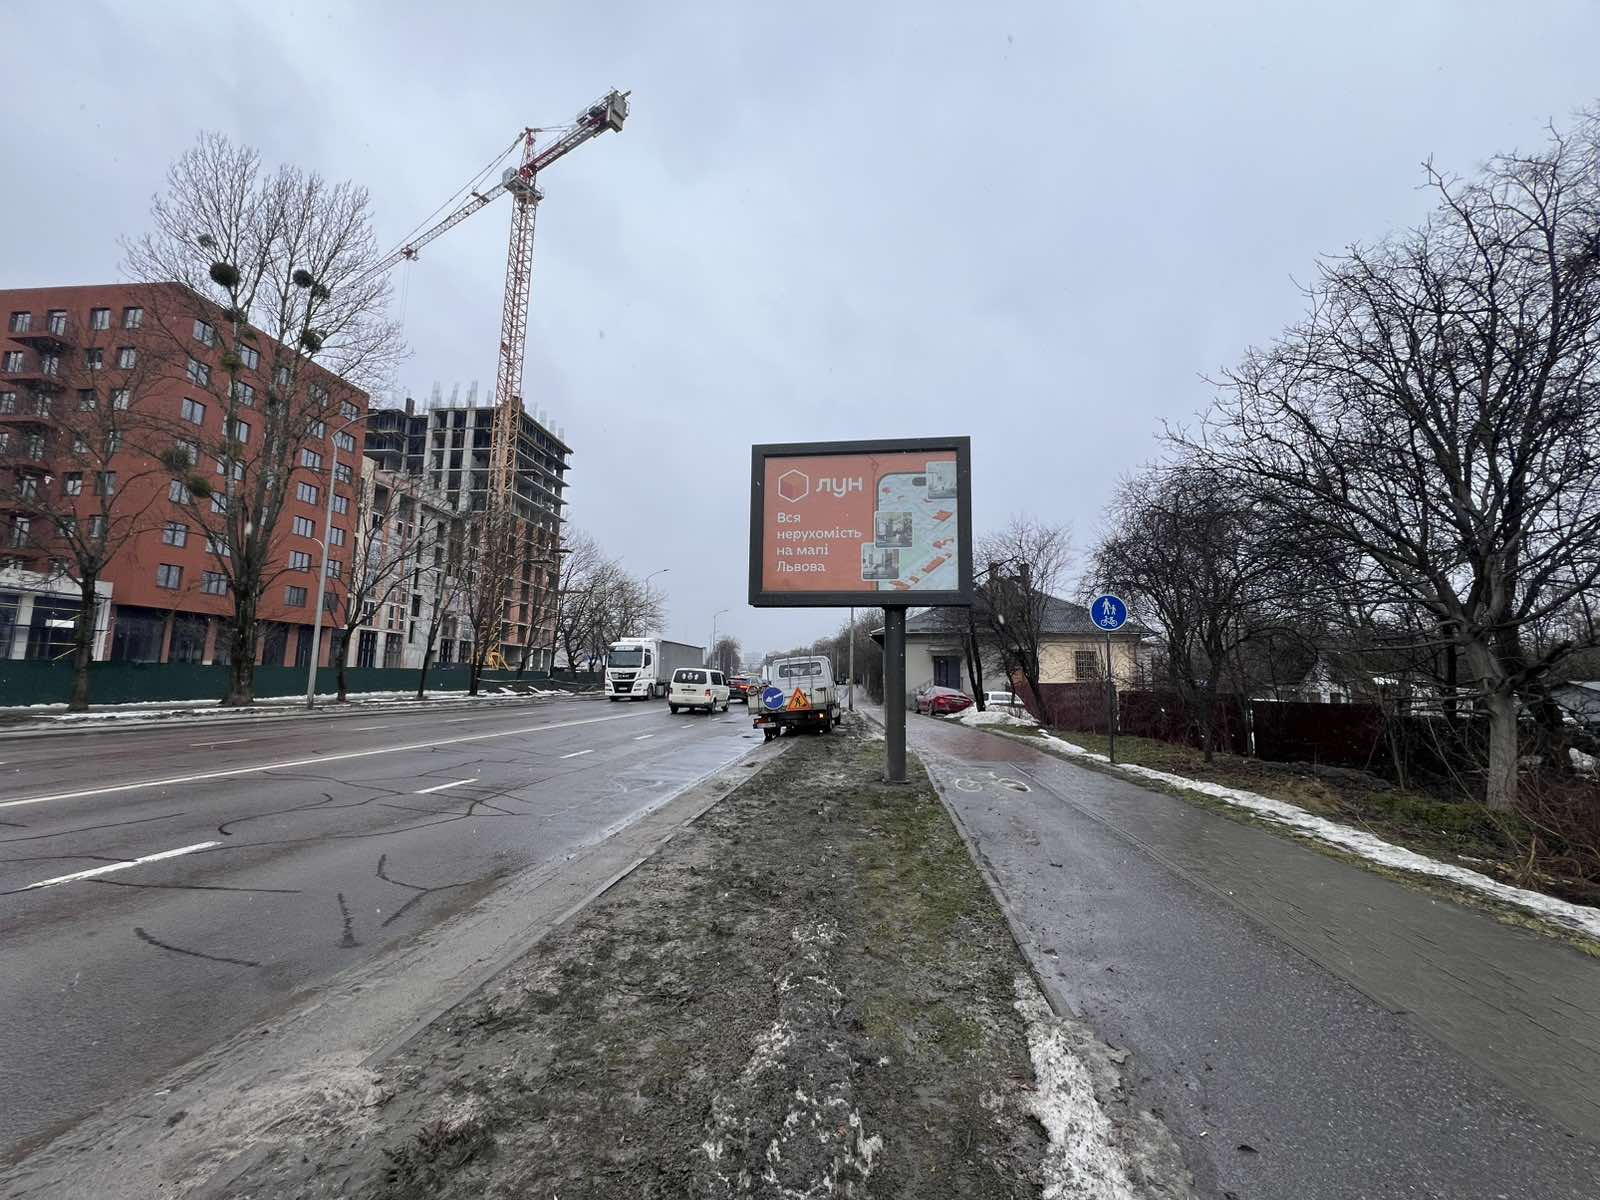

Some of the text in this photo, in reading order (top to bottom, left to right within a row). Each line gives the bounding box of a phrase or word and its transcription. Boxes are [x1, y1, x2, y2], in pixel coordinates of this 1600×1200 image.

[777, 512, 801, 523] Вся
[776, 526, 863, 542] нерухомість
[776, 543, 829, 556] на мапі
[776, 560, 826, 573] Львова
